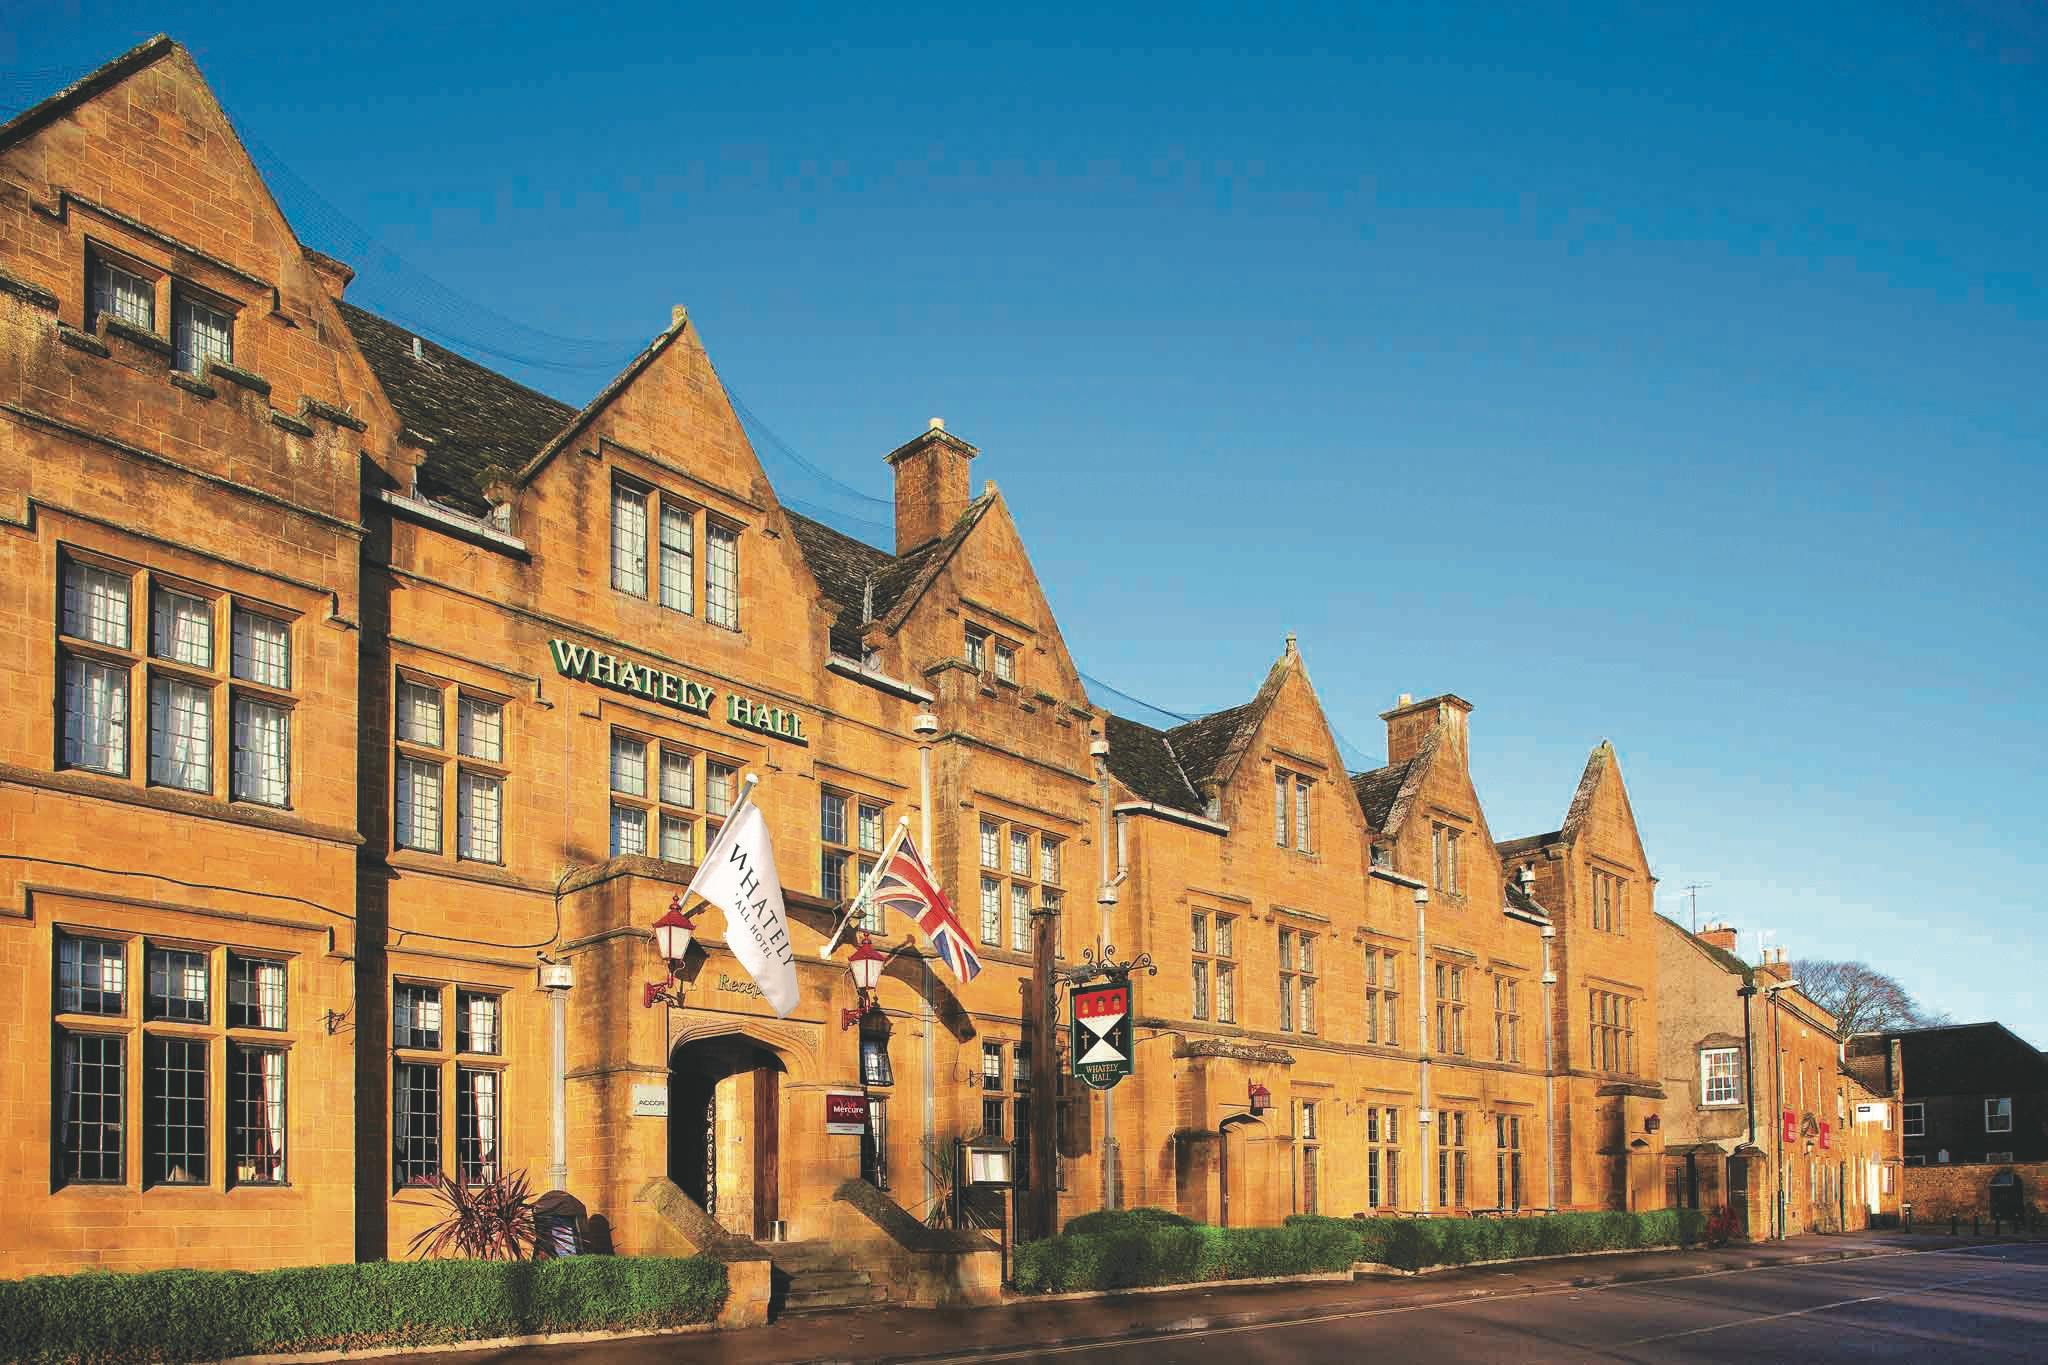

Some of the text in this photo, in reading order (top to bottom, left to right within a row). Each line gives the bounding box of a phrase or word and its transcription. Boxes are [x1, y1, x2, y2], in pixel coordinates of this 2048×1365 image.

[549, 639, 808, 747] WHATELY HALL
[729, 843, 794, 966] WHATELY
[735, 893, 772, 959] ALL HOTEL
[1086, 1063, 1118, 1074] WHATELY
[1091, 1073, 1112, 1082] HALL
[833, 1105, 864, 1114] Mercure
